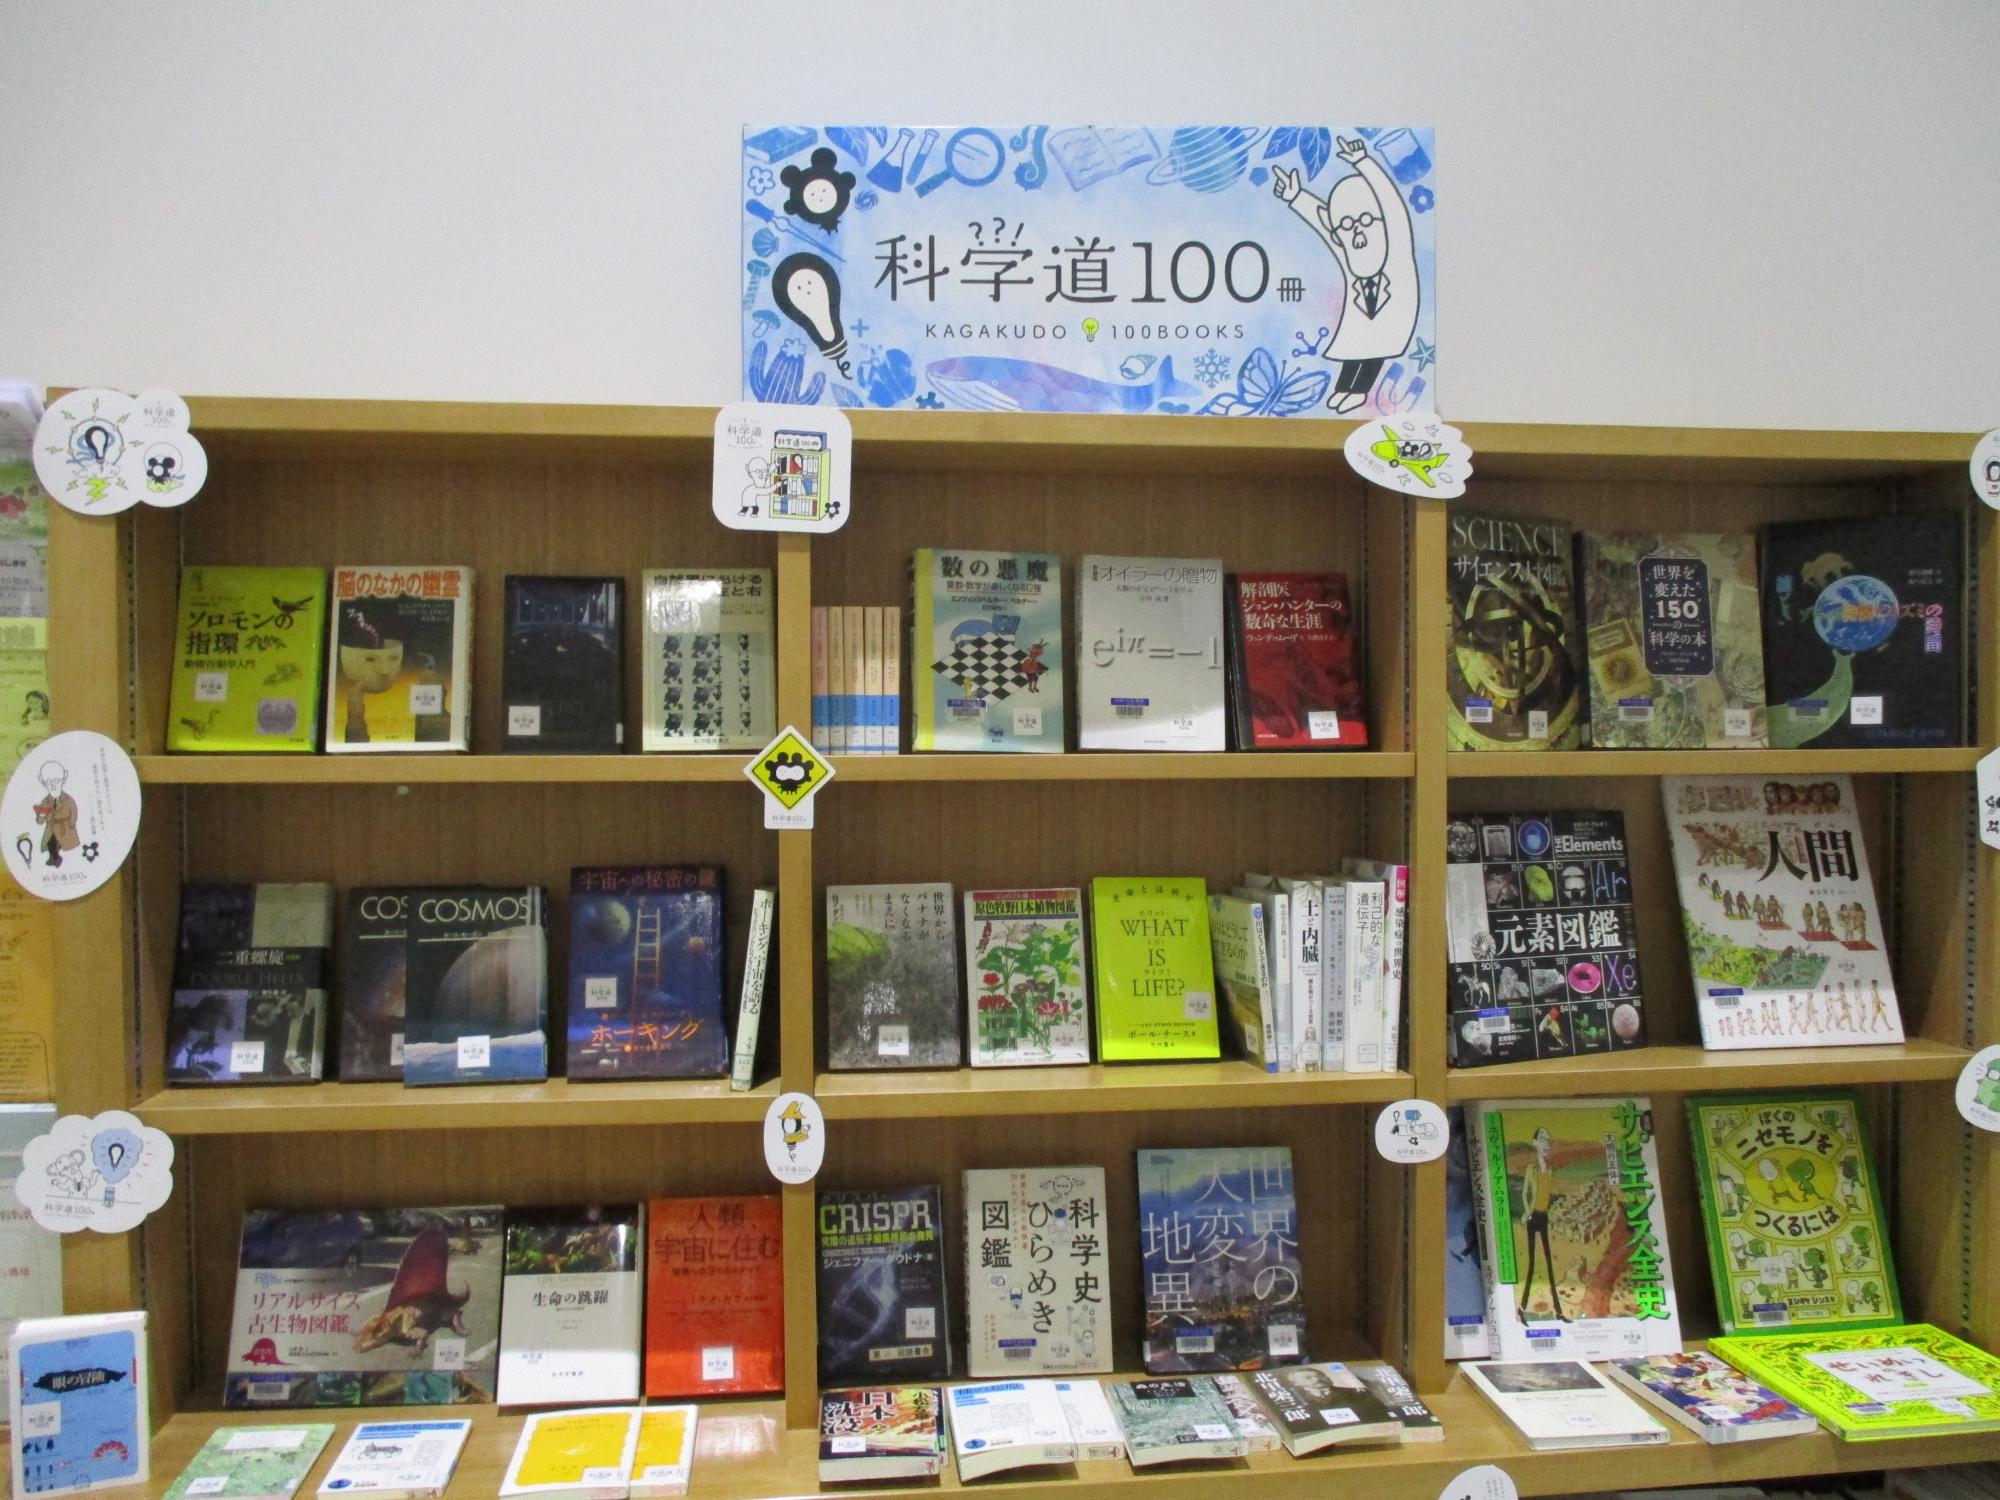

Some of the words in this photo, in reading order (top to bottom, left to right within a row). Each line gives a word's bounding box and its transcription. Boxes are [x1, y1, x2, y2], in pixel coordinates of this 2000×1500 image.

[873, 220, 1306, 304] 科学道100冊
[925, 323, 1068, 341] KAGAKUDO
[1111, 323, 1245, 342] 100BOOKS
[941, 555, 1050, 583] 数の悪魔
[1100, 565, 1218, 585] オイラーの贈物
[1652, 564, 1695, 580] 世界を
[336, 569, 461, 599] 脳のなかの幽霊
[1240, 581, 1290, 598] 解剖医
[1653, 582, 1697, 600] 変えた
[1243, 598, 1343, 613] ジョン・ハンターの
[1655, 599, 1699, 619] 150
[186, 610, 294, 631] ソロモンの
[1244, 612, 1324, 631] 数奇な生涯
[185, 632, 240, 656] 指環
[1649, 630, 1707, 647] 科学の本
[1562, 835, 1625, 853] Elements
[1756, 829, 1860, 883] 人間
[579, 869, 717, 890] 宇宙への秘密の鍵
[1112, 885, 1195, 904] 生命とは何か
[418, 896, 532, 923] COSMOS
[884, 893, 896, 930] まえに
[900, 893, 912, 943] なくなる
[917, 892, 930, 941] バナナが
[933, 891, 945, 941] 世界から
[1356, 892, 1369, 935] 遺伝子
[1370, 892, 1383, 947] 利己的な
[1119, 918, 1190, 938] WHAT
[1300, 898, 1320, 964] 土と内臓
[1494, 909, 1624, 957] 元素図鑑
[1147, 948, 1167, 967] IS
[1591, 954, 1601, 963] 53
[1132, 978, 1186, 997] LIFE?
[1604, 953, 1637, 993] Xe
[591, 1018, 704, 1043] ホーキング
[1759, 1109, 1796, 1126] ぼくの
[1735, 1125, 1834, 1160] ニセモノを
[818, 1198, 935, 1236] CRISPR
[1612, 1100, 1671, 1321] サピエンス全史
[1754, 1205, 1841, 1237] つくるには
[980, 1199, 1013, 1270] 図鑑
[1248, 1150, 1299, 1306] 世界の
[653, 1235, 780, 1265] 宇宙に住む
[1068, 1196, 1102, 1304] 科学史
[1027, 1199, 1058, 1334] ひらめき
[1141, 1210, 1199, 1327] 地異
[531, 1289, 610, 1309] 生命の跳躍
[248, 1313, 350, 1336] 古生物図鑑
[822, 1401, 864, 1436] 沈没
[863, 1391, 894, 1421] 日本
